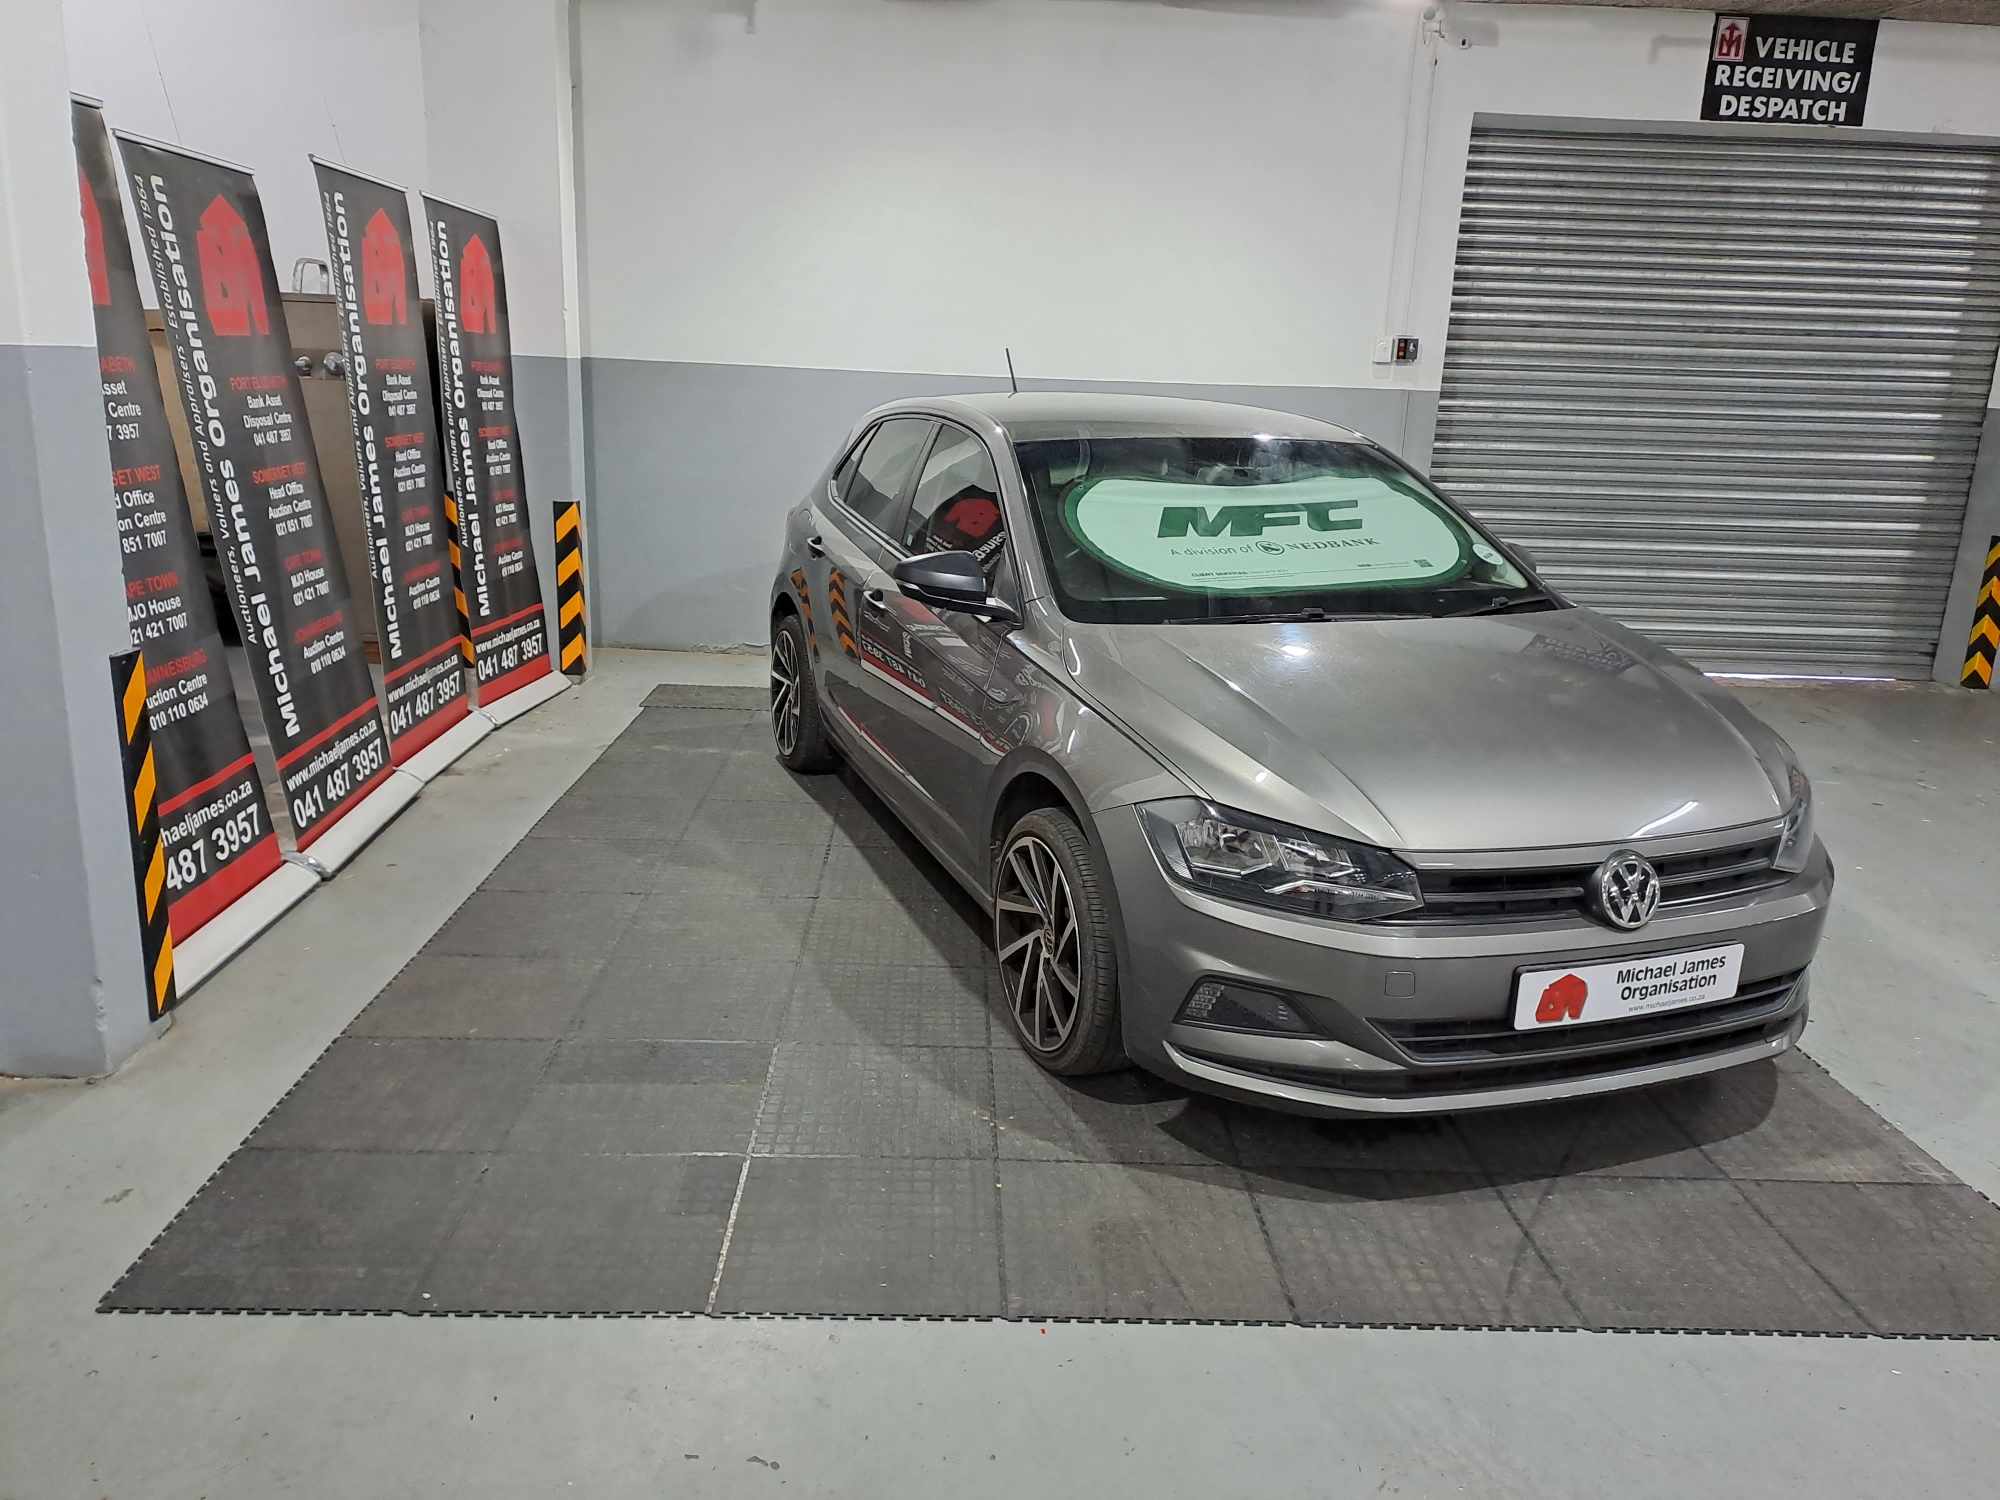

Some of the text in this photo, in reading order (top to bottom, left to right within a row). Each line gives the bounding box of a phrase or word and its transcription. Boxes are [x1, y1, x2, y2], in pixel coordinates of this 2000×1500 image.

[1756, 36, 1857, 64] VEHICLE
[1714, 64, 1862, 94] RECEIVING/
[1719, 94, 1847, 122] DESPATCH
[134, 174, 152, 220] 1964
[144, 224, 178, 328] Established
[176, 345, 206, 436] Appraisers
[246, 394, 265, 408] Bank
[108, 402, 142, 418] Centre
[243, 414, 273, 430] Disposal
[334, 192, 402, 660] Michael James Organisation
[436, 220, 490, 616] Michael James Organisation
[116, 424, 140, 440] 3957
[150, 175, 300, 738] Michael James Organisation
[198, 440, 214, 473] and
[123, 490, 155, 508] Office
[209, 478, 229, 539] Valuers
[134, 510, 167, 528] Centre
[1158, 500, 1363, 538] MFC
[122, 530, 167, 554] 851 7007
[1182, 546, 1235, 556] division
[1240, 544, 1254, 552] of
[1287, 538, 1380, 551] NEDBANK
[149, 596, 182, 616] House
[228, 546, 258, 644] Auctioneers,
[130, 612, 188, 646] 21 421 7007
[478, 633, 542, 680] 041 487 3957
[178, 672, 208, 694] Centre
[150, 692, 209, 732] 010 110 0634
[390, 670, 460, 734] 041 487 3957
[294, 738, 383, 828] 041 487 3957
[166, 802, 260, 892] 487 3957
[1616, 954, 1726, 984] Michael James
[1620, 972, 1717, 1000] Organisation
